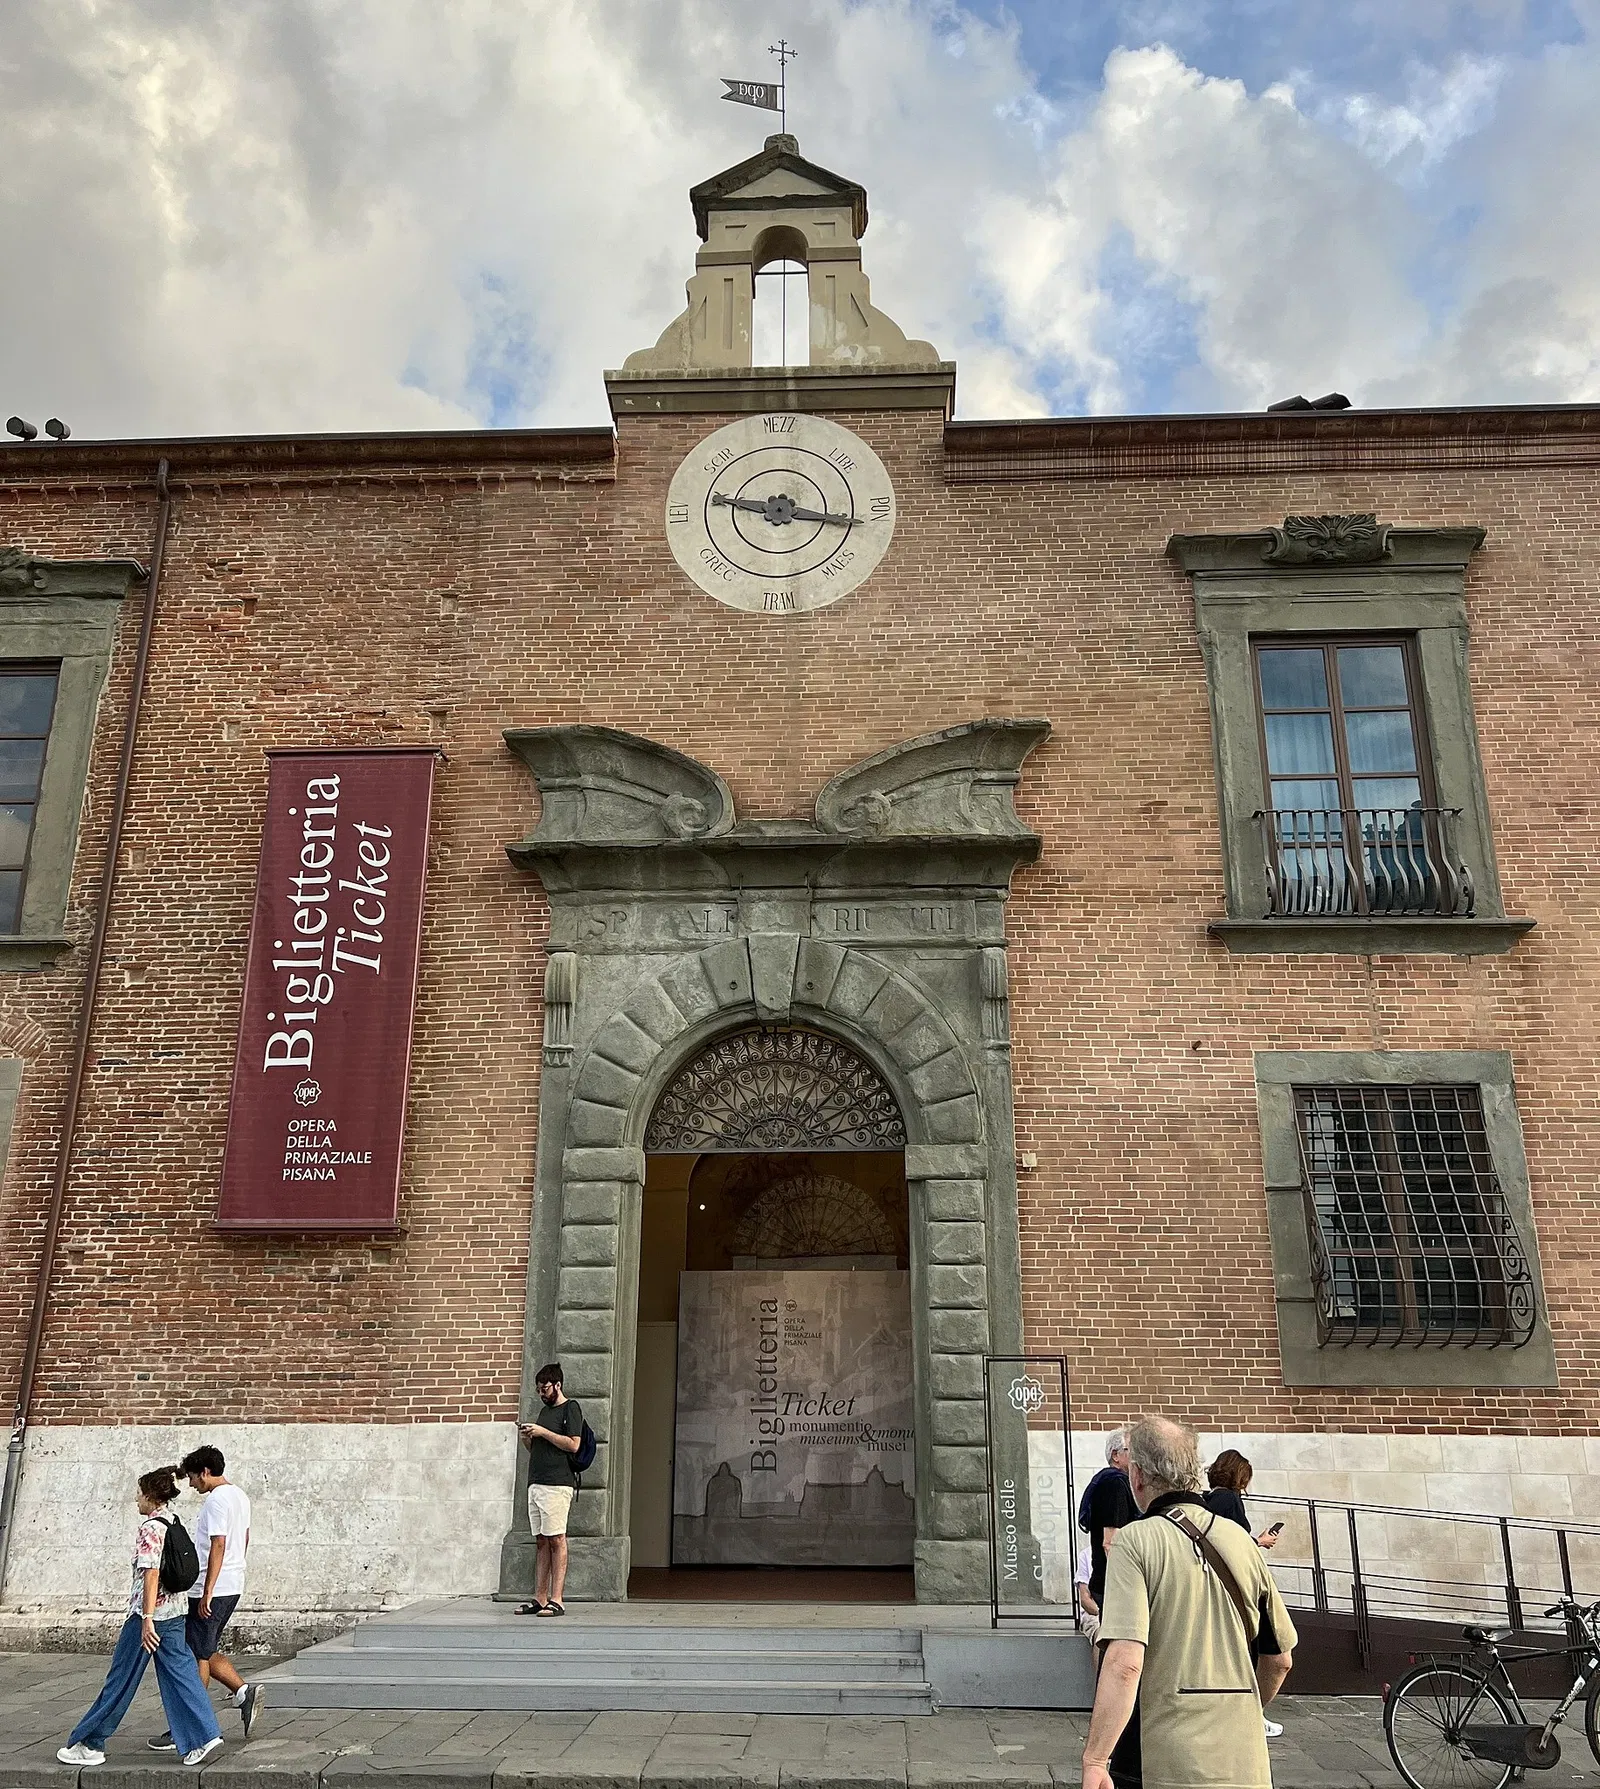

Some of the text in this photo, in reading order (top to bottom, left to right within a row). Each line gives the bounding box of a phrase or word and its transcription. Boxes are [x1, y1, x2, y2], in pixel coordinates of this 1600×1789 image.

[763, 416, 797, 434] MEZZ
[703, 447, 735, 475] SCIR
[828, 447, 858, 474] LIBE
[869, 496, 891, 521] PON
[699, 548, 737, 582] GREC
[821, 549, 855, 579] MAES
[762, 591, 796, 611] TRAM
[331, 820, 393, 975] Ticket
[262, 773, 341, 1073] Biglietteria
[288, 1119, 337, 1132] OPERA
[286, 1135, 333, 1149] DELLA
[284, 1151, 373, 1165] PRIMAZIALE
[282, 1167, 337, 1181] PISANA
[749, 1297, 785, 1474] Biglietteria
[780, 1391, 856, 1417] Ticket
[789, 1419, 864, 1432] monumenti
[799, 1435, 906, 1451] museums musei
[1000, 1479, 1018, 1581] Museo delle
